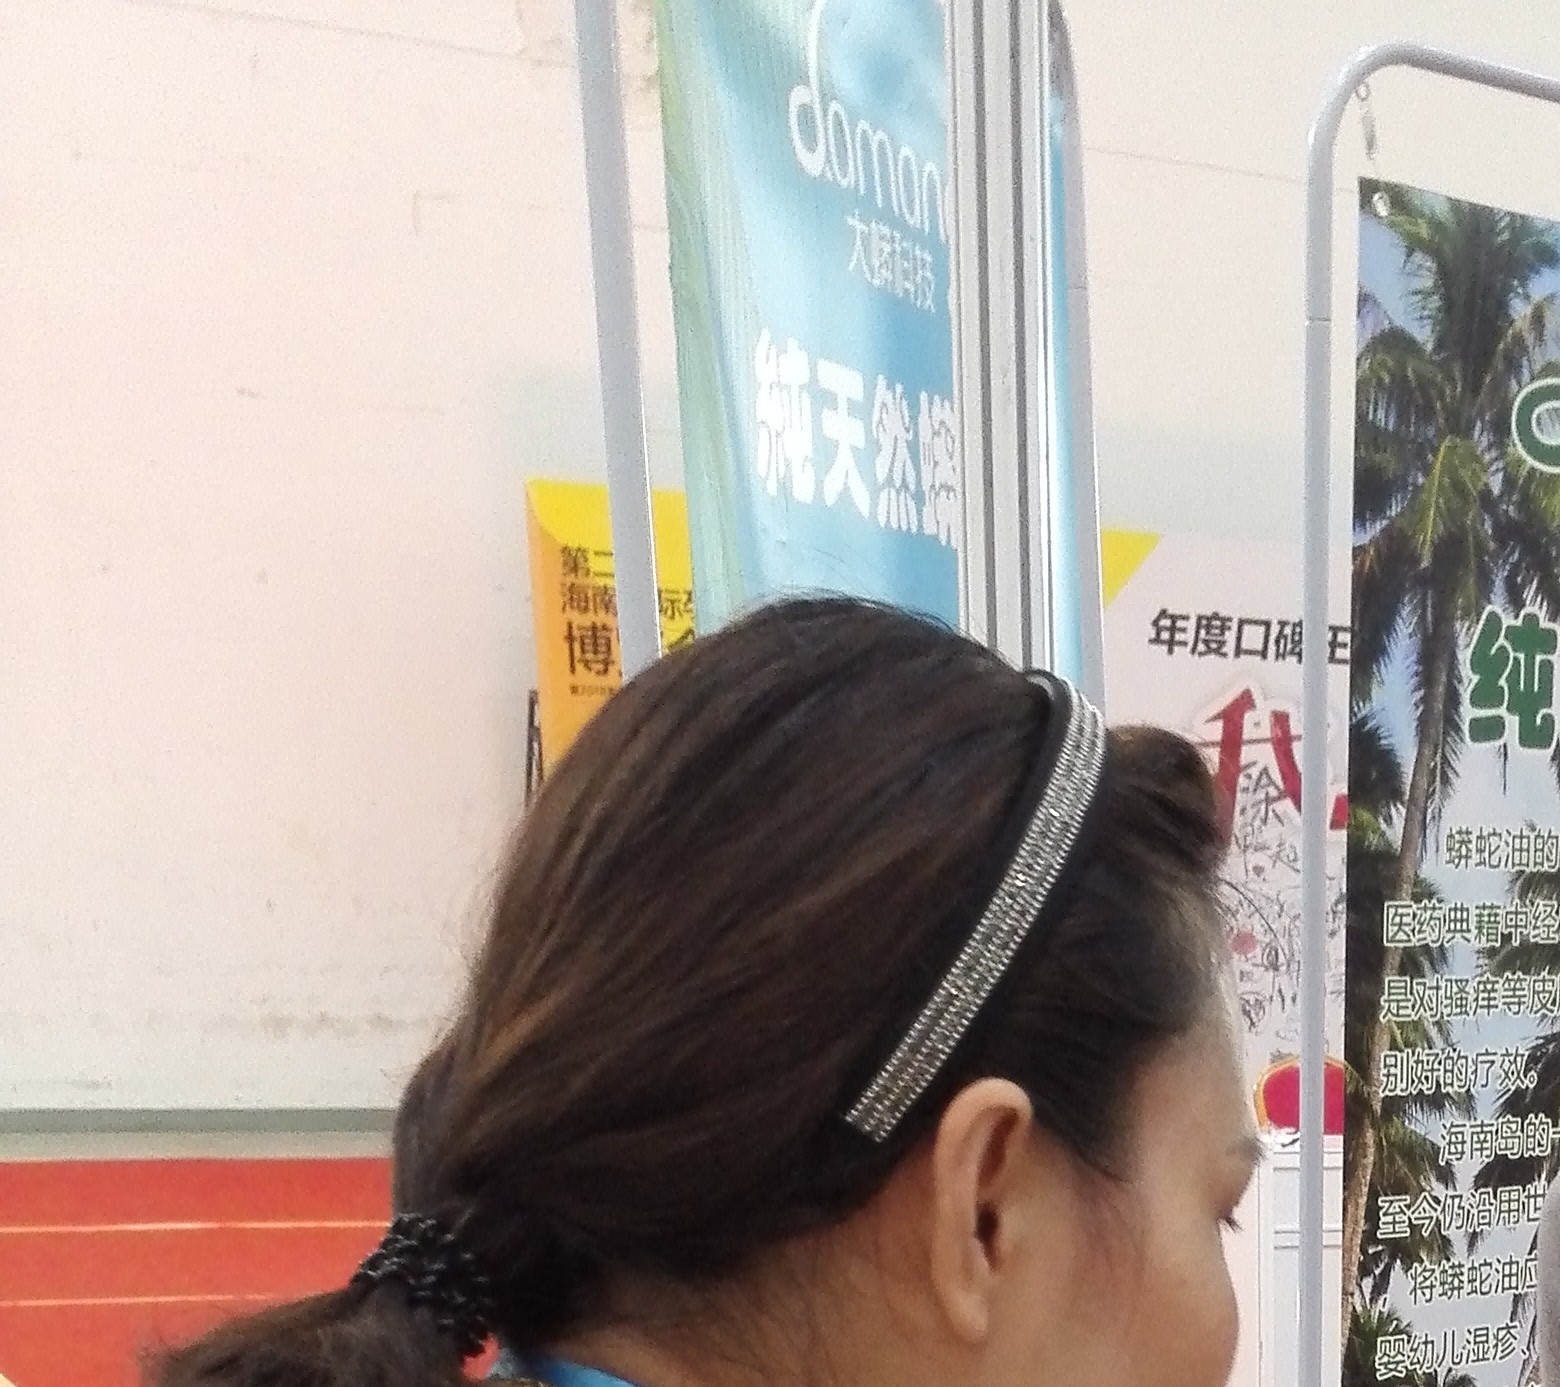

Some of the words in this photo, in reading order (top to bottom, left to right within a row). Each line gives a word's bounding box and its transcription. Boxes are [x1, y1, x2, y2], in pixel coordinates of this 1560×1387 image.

[1381, 1047, 1539, 1097] 别好的疗效。
[1376, 1322, 1530, 1380] 婴幼儿湿疹、
